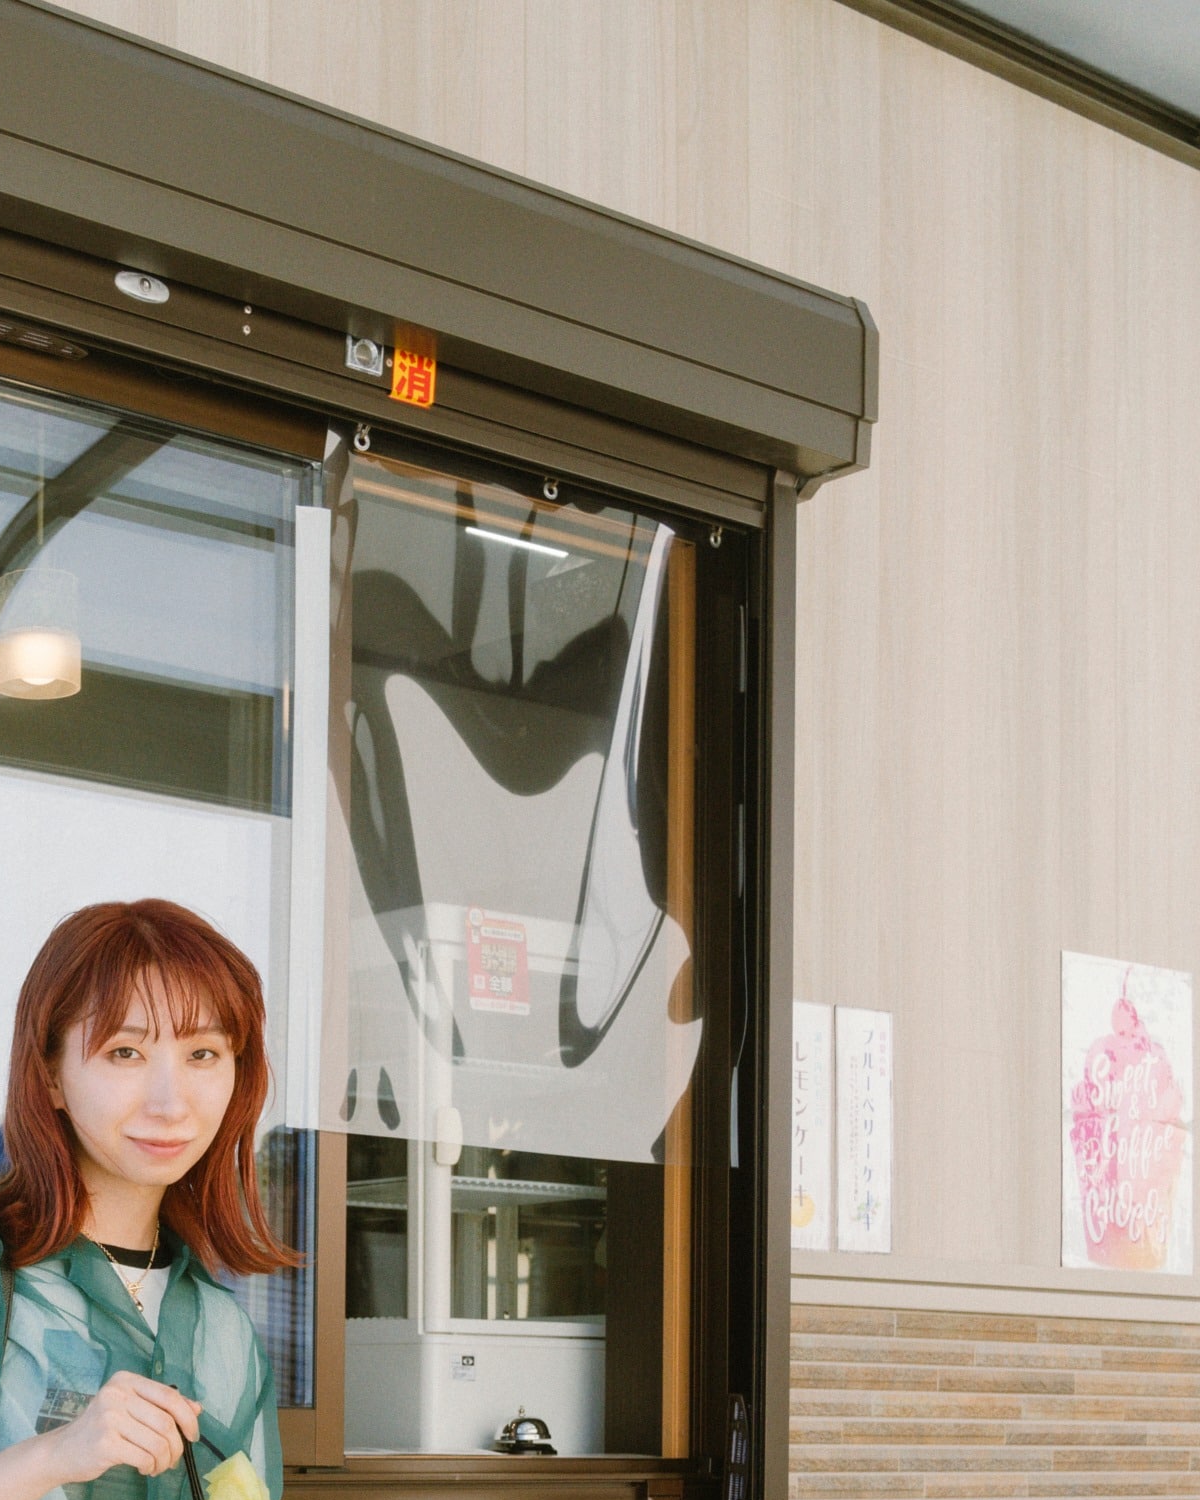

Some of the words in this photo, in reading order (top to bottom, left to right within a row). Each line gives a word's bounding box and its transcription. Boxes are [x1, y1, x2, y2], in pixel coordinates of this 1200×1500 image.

[395, 349, 434, 403] 消
[1090, 1053, 1160, 1110] Sweets
[794, 1040, 809, 1208] レモンケーキ
[1102, 1114, 1174, 1178] Coffee
